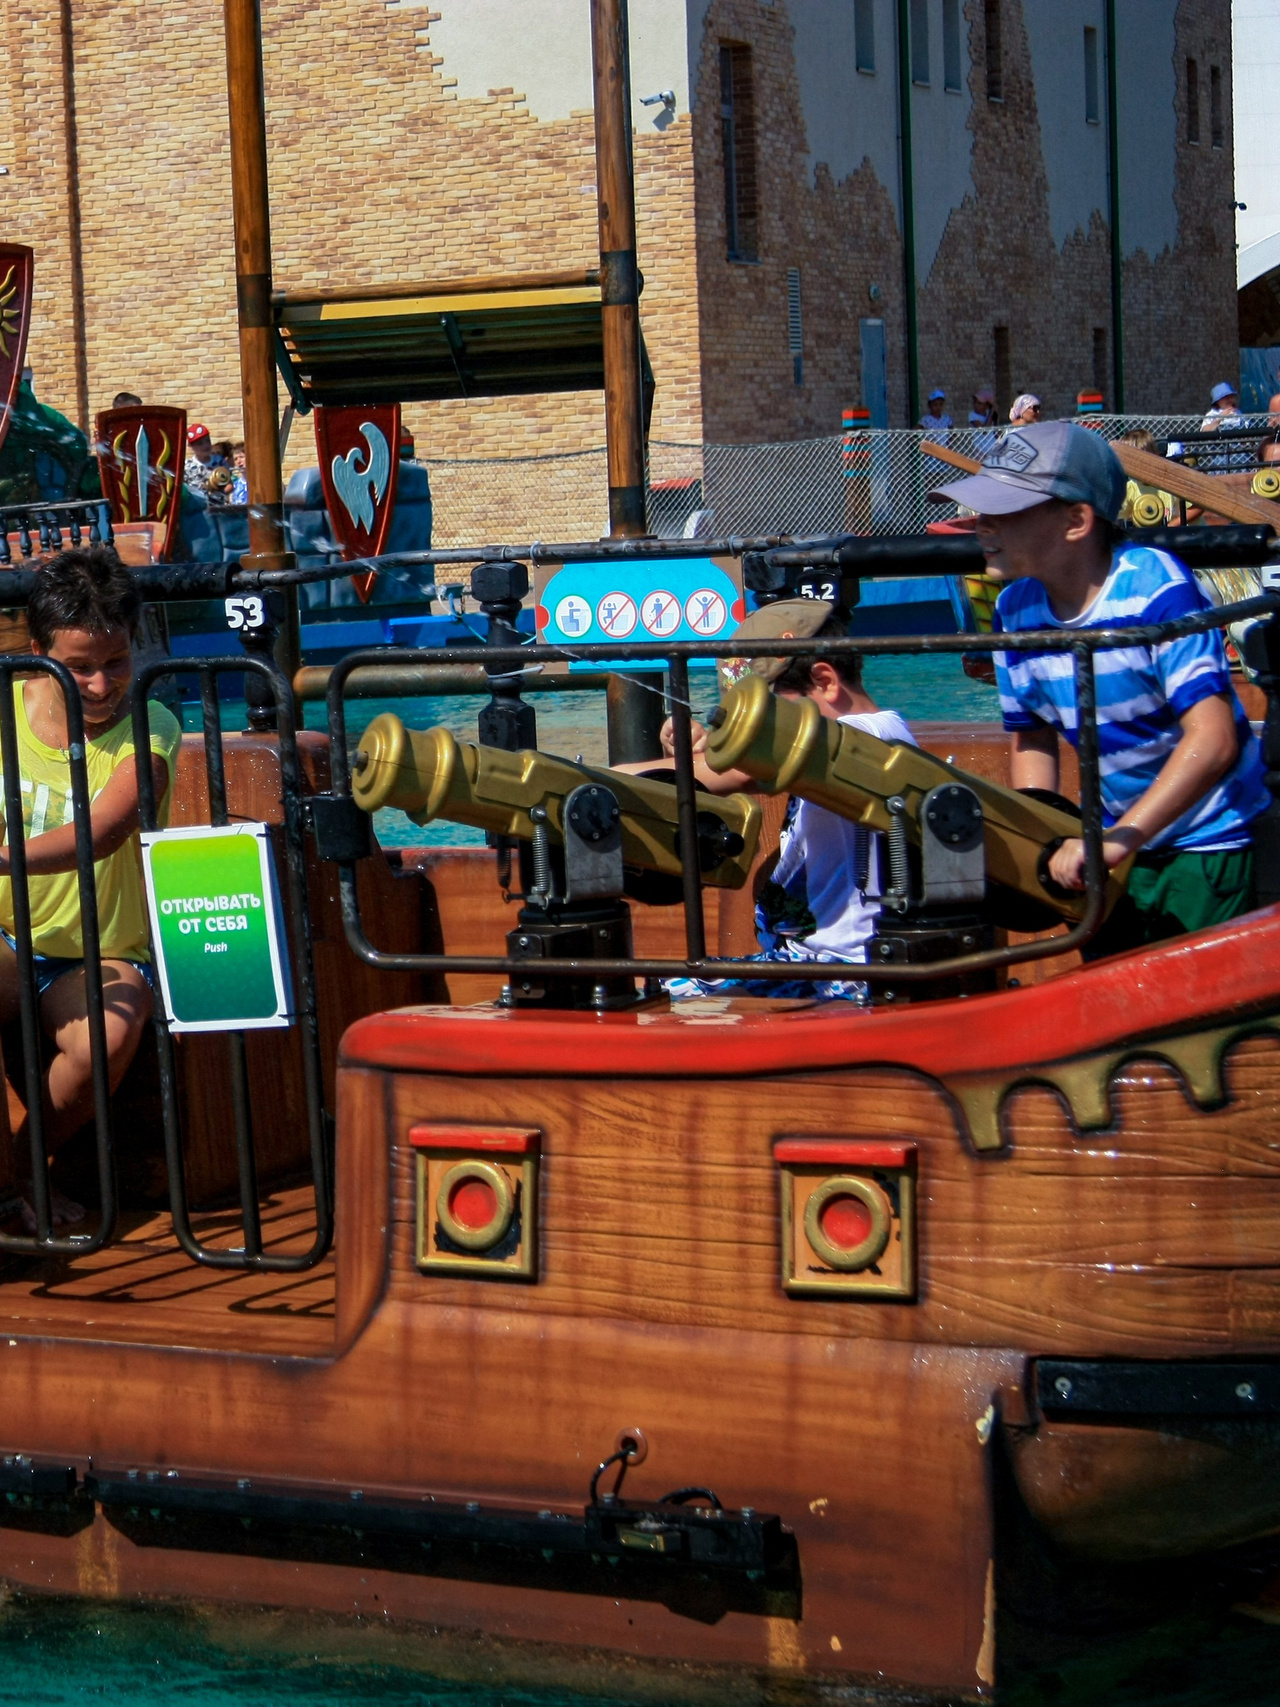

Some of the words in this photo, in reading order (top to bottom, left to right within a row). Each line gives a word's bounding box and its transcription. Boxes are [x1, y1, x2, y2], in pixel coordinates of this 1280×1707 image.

[801, 583, 835, 600] 5.2
[225, 596, 265, 631] 5.3
[160, 893, 261, 915] ОТКРЫВАТЬ
[178, 918, 201, 934] ОТ
[205, 915, 248, 932] СЕБЯ
[204, 942, 228, 953] Push
